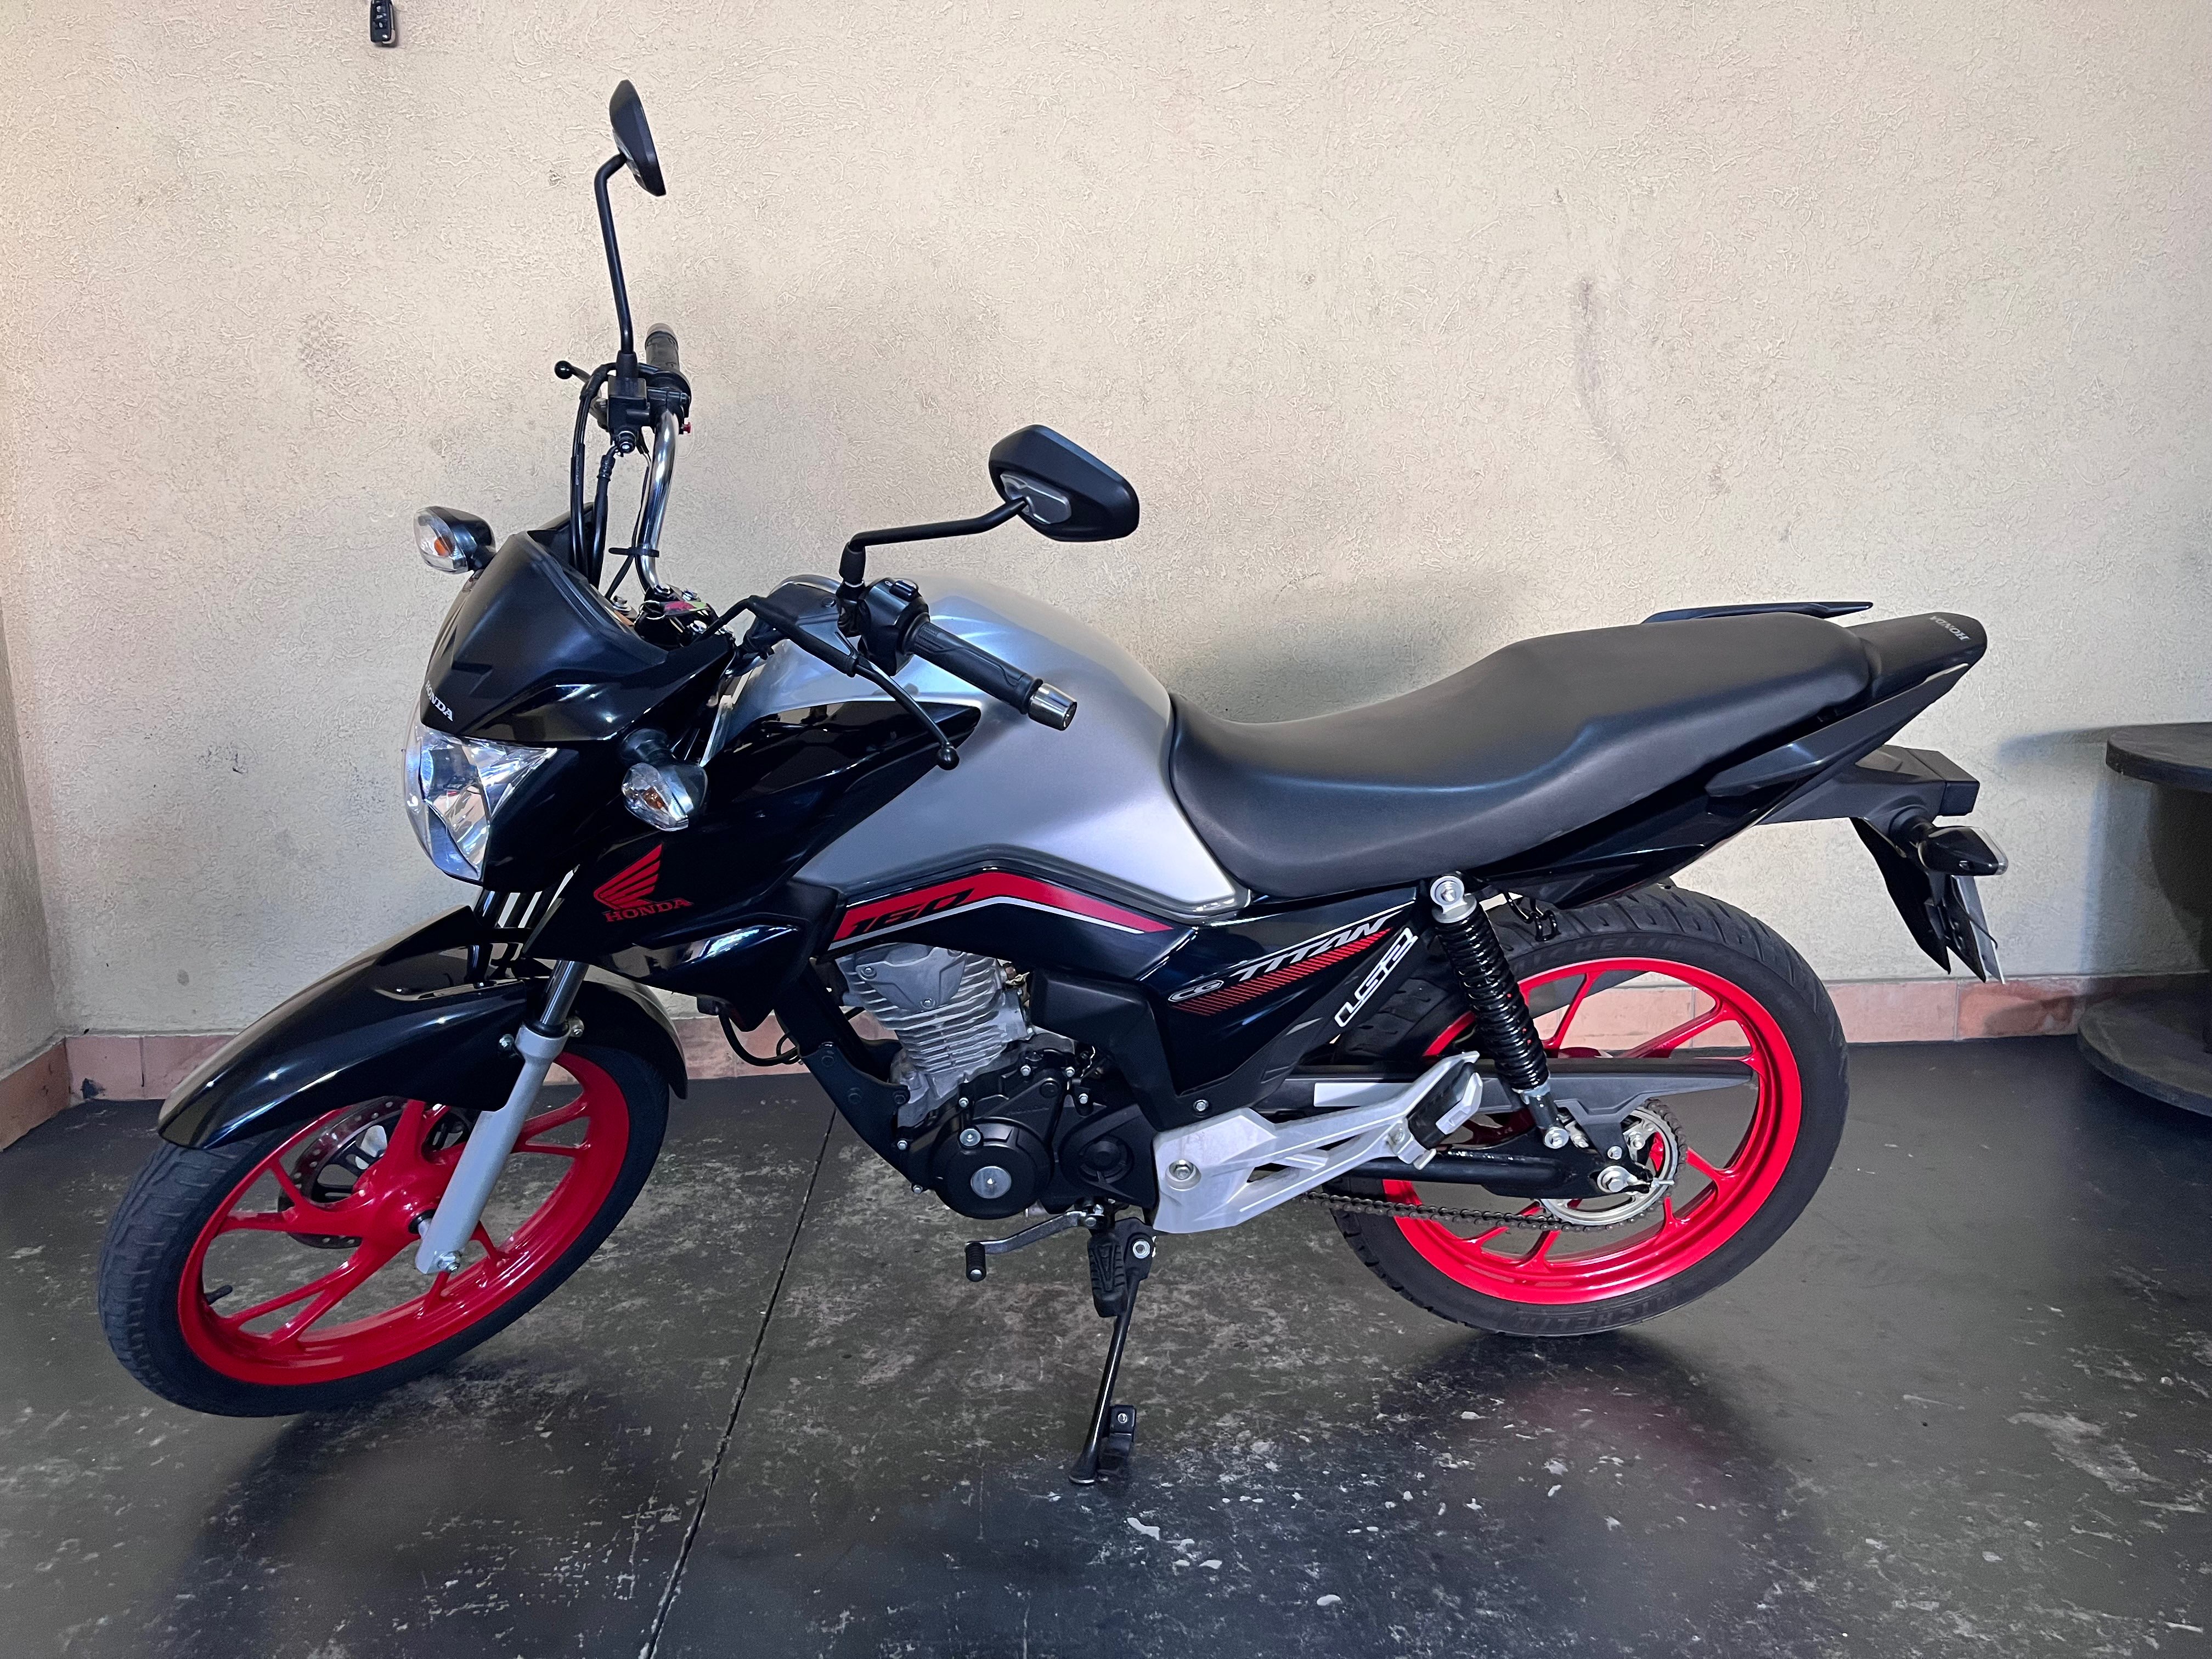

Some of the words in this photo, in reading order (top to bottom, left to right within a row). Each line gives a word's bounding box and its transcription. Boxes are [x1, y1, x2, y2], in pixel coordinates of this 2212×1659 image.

[1930, 616, 1971, 641] HONDA
[425, 680, 453, 721] HONDA
[604, 898, 693, 922] HONDA
[848, 887, 975, 936] 160
[1170, 980, 1222, 1001] CG
[1229, 910, 1402, 981] TITAN
